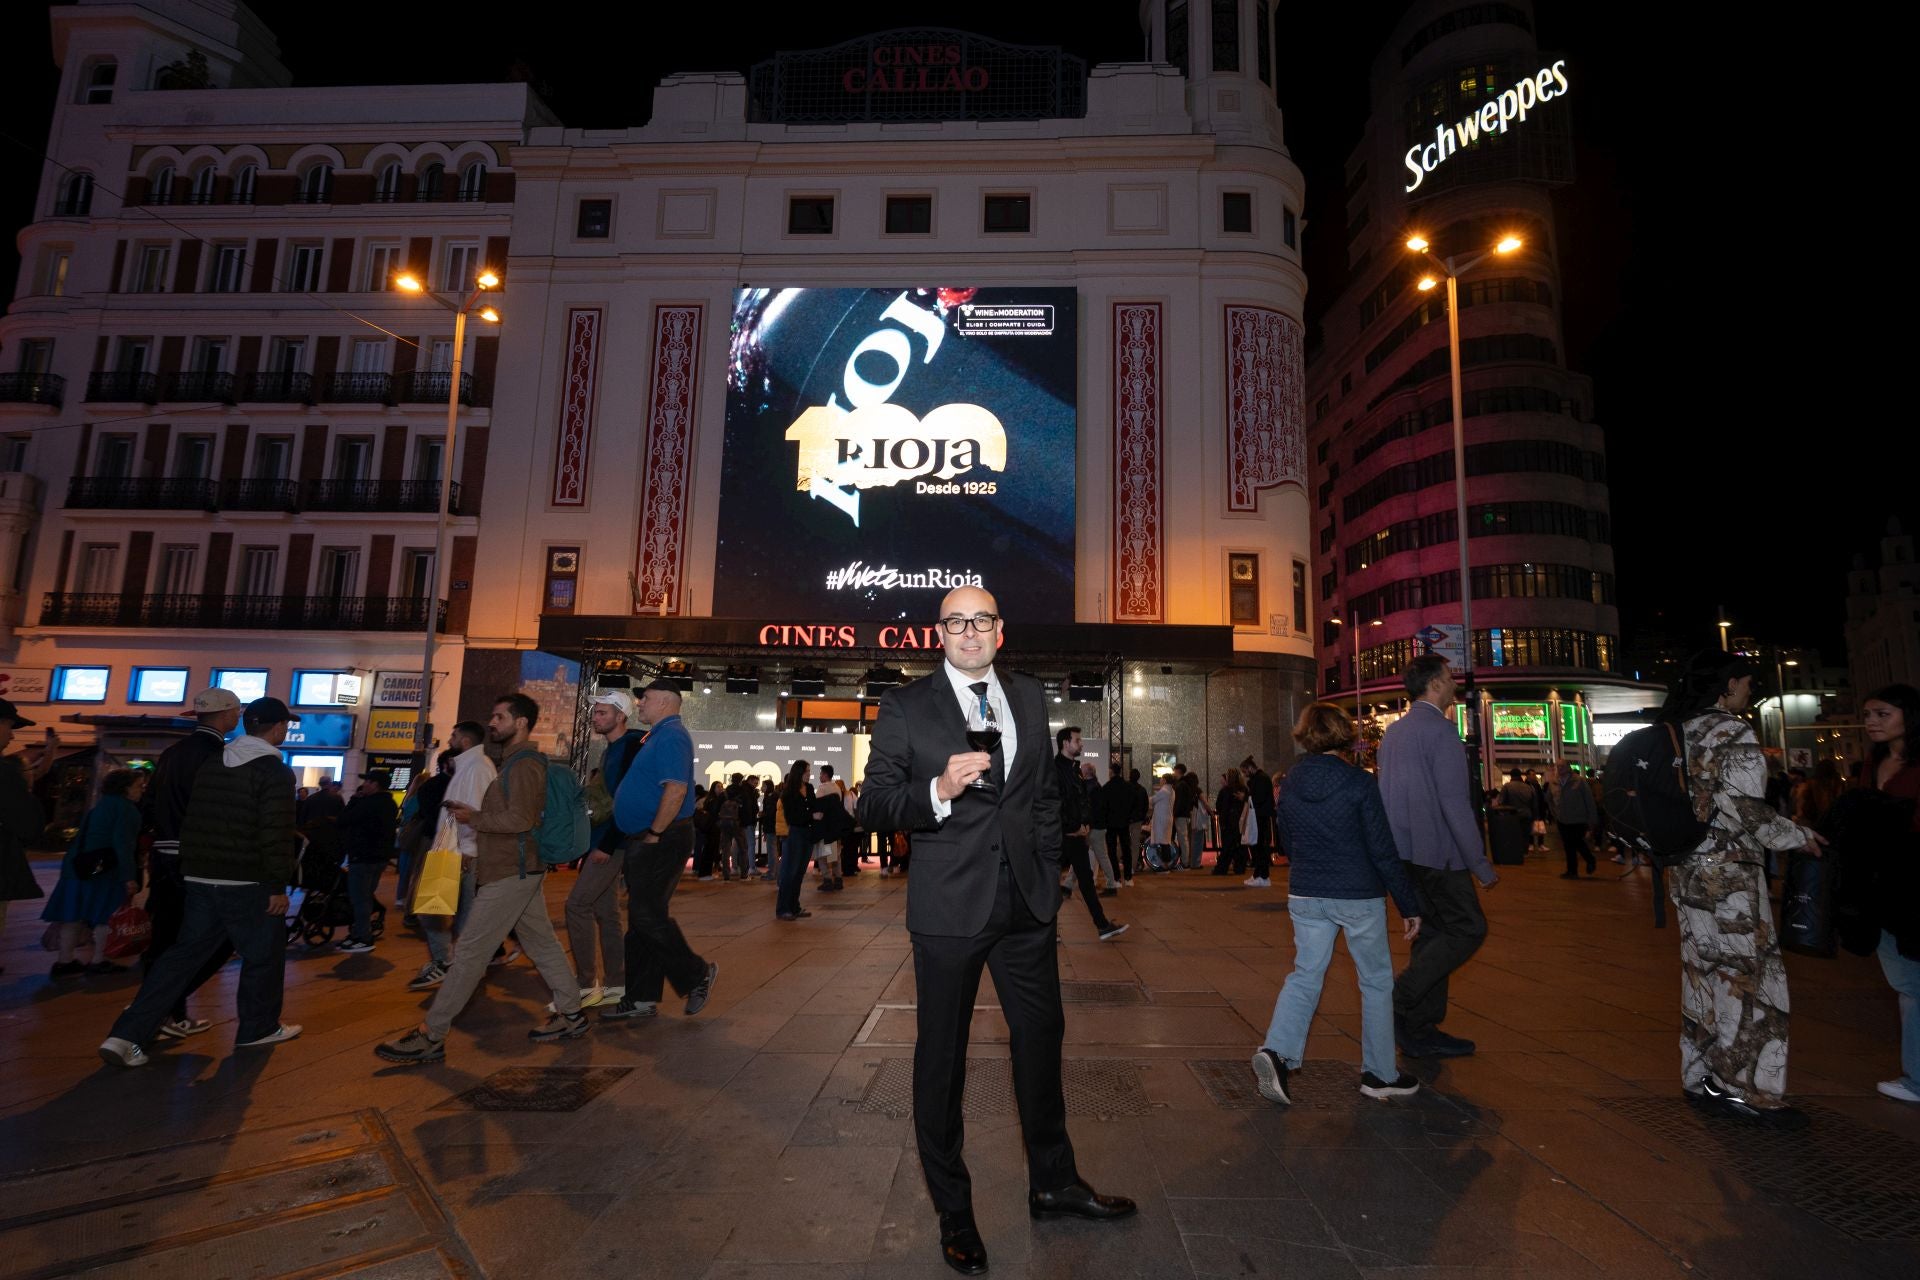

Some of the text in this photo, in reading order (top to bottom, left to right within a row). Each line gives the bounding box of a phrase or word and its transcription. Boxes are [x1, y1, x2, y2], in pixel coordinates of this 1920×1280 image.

[873, 45, 961, 66] CINES
[842, 66, 990, 94] CALLAO
[1404, 60, 1569, 193] Schweppes
[916, 481, 997, 495] Desde 1925
[759, 624, 856, 648] CINES
[374, 730, 413, 739] CHANG
